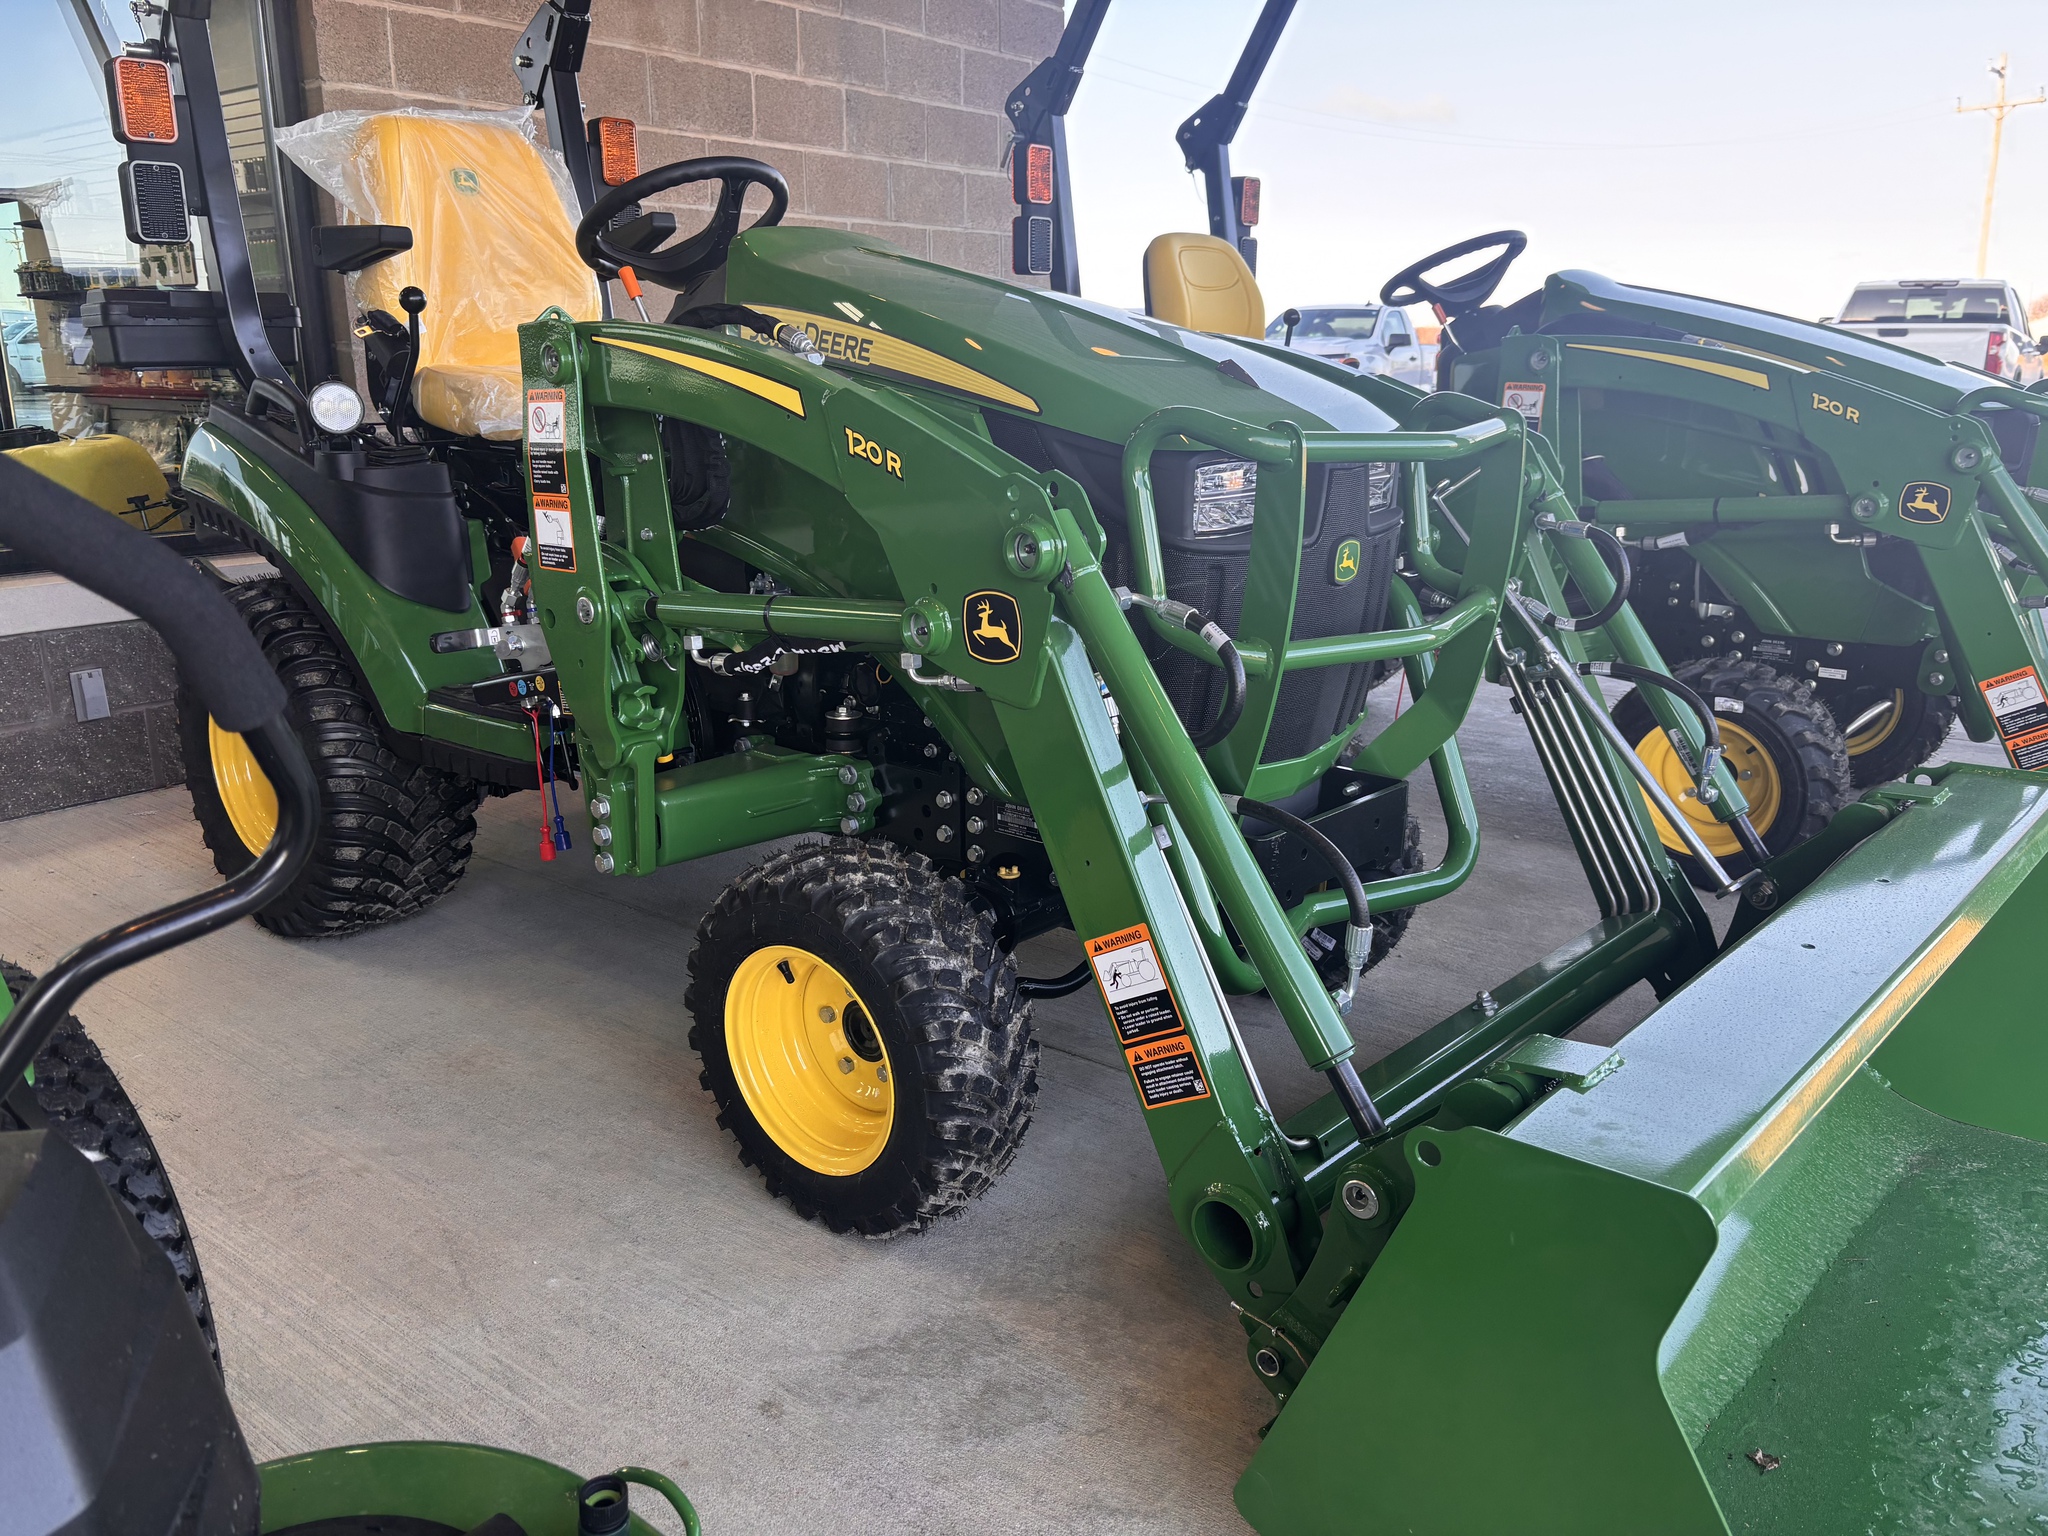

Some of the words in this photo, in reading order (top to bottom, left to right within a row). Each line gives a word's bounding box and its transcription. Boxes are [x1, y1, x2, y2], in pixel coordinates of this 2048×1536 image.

[804, 321, 874, 363] DEERE
[535, 391, 563, 400] WARNING
[540, 499, 568, 510] WARNING
[1993, 670, 2028, 685] WARNING
[2020, 731, 2048, 744] WARNIN
[1102, 930, 1142, 949] WARNING
[1144, 1042, 1185, 1058] WARNING
